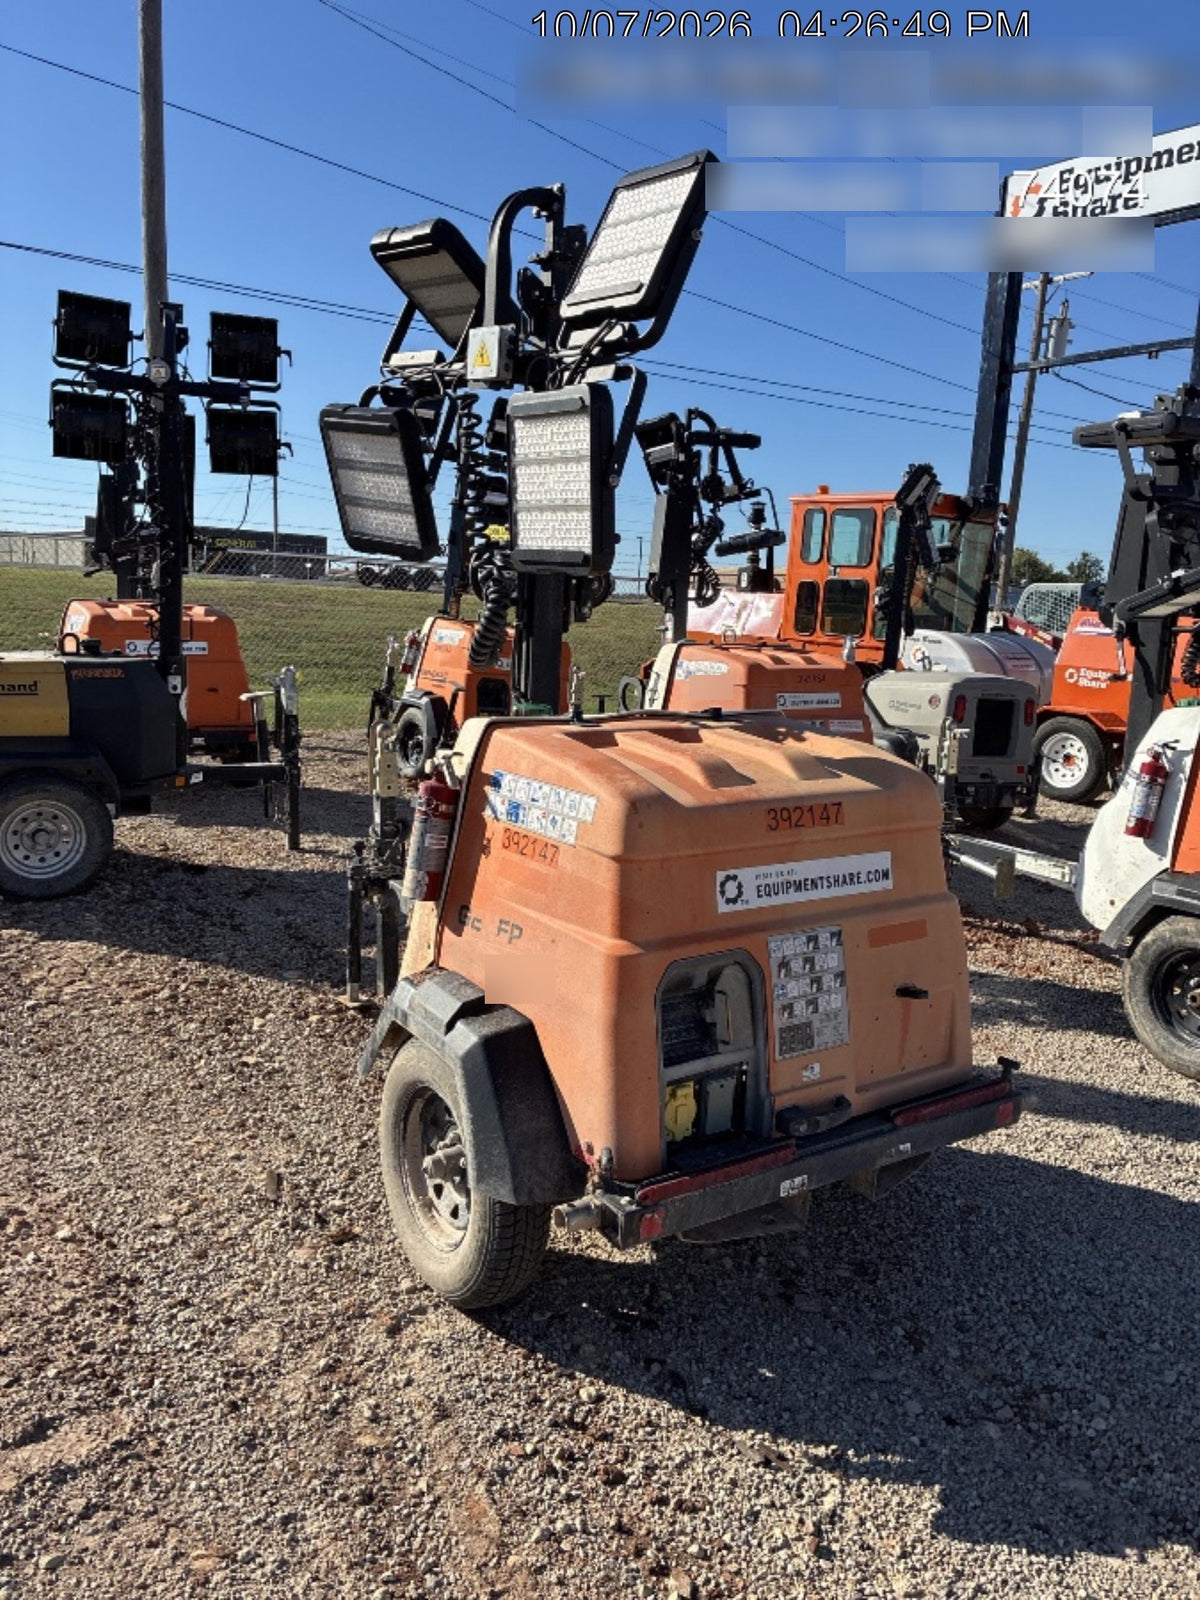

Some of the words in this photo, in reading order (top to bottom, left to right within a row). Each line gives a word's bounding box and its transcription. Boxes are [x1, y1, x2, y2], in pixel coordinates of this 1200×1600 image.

[766, 802, 843, 832] 392147
[502, 827, 560, 867] 392147
[756, 868, 890, 899] EQUIPMENTSHARE.COM
